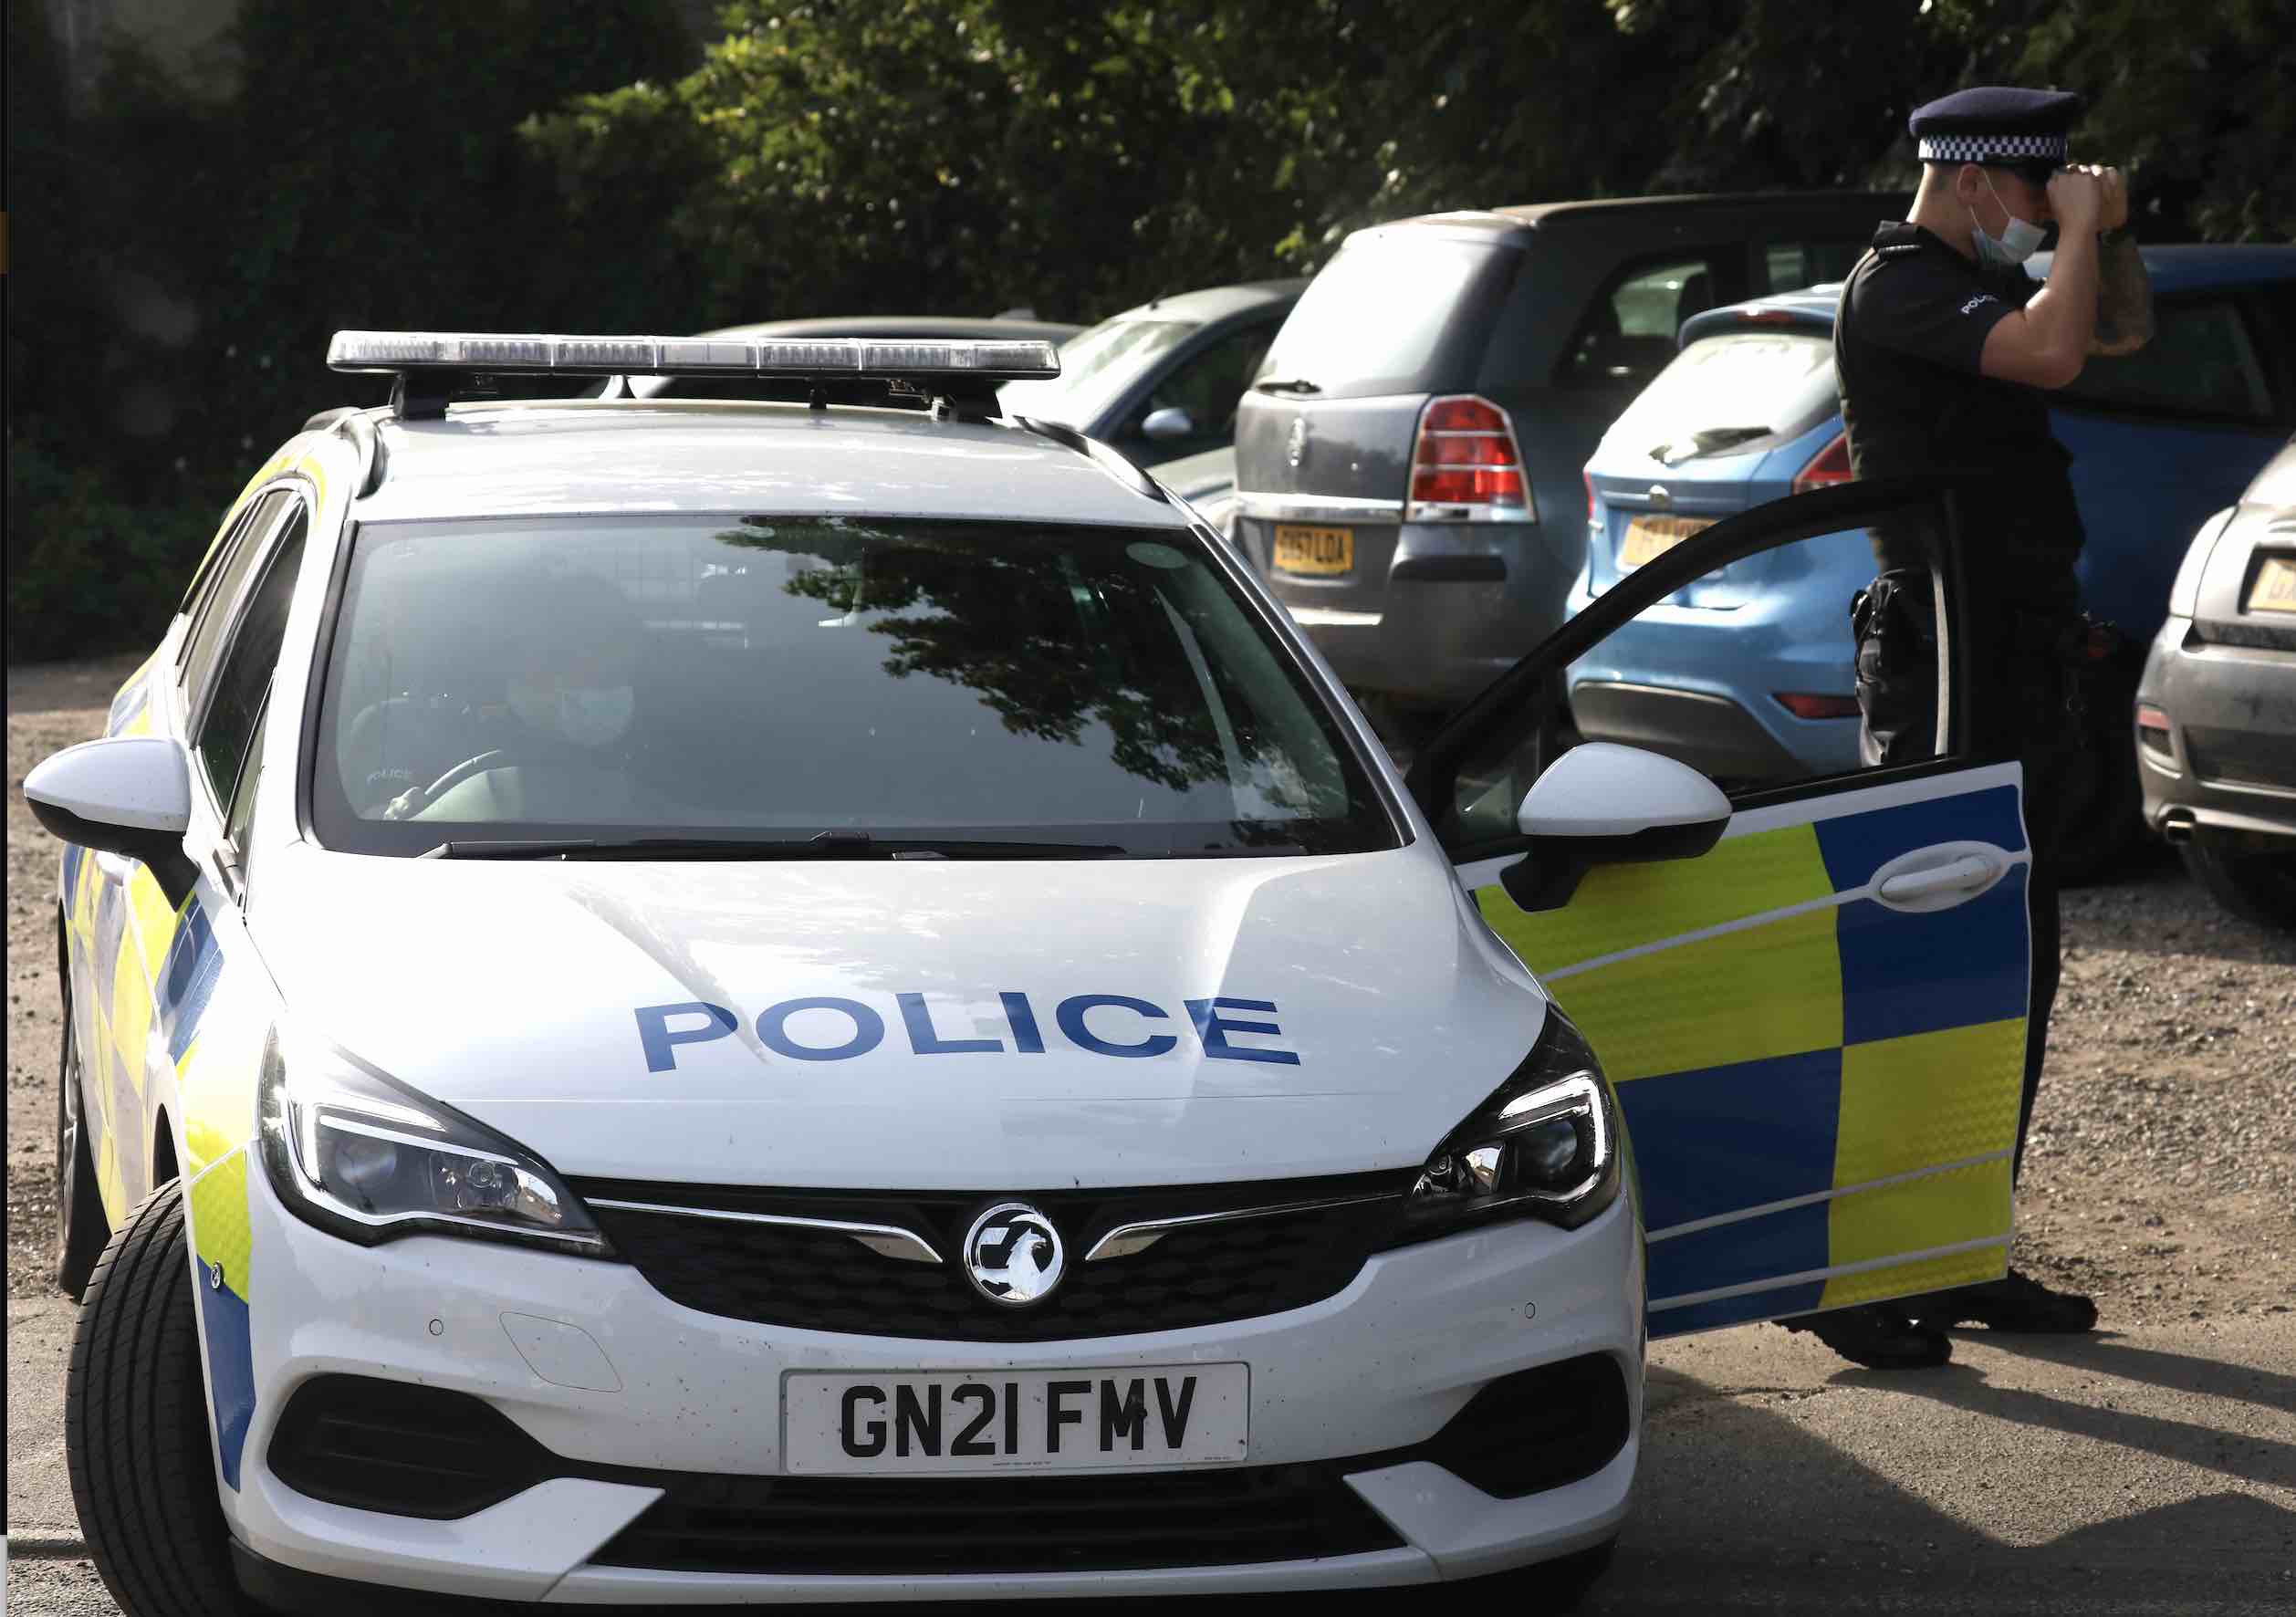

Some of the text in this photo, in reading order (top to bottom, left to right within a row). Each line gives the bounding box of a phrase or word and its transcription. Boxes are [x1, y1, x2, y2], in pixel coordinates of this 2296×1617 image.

[633, 992, 1300, 1072] POLICE
[840, 1376, 1197, 1457] GN21 FMV
